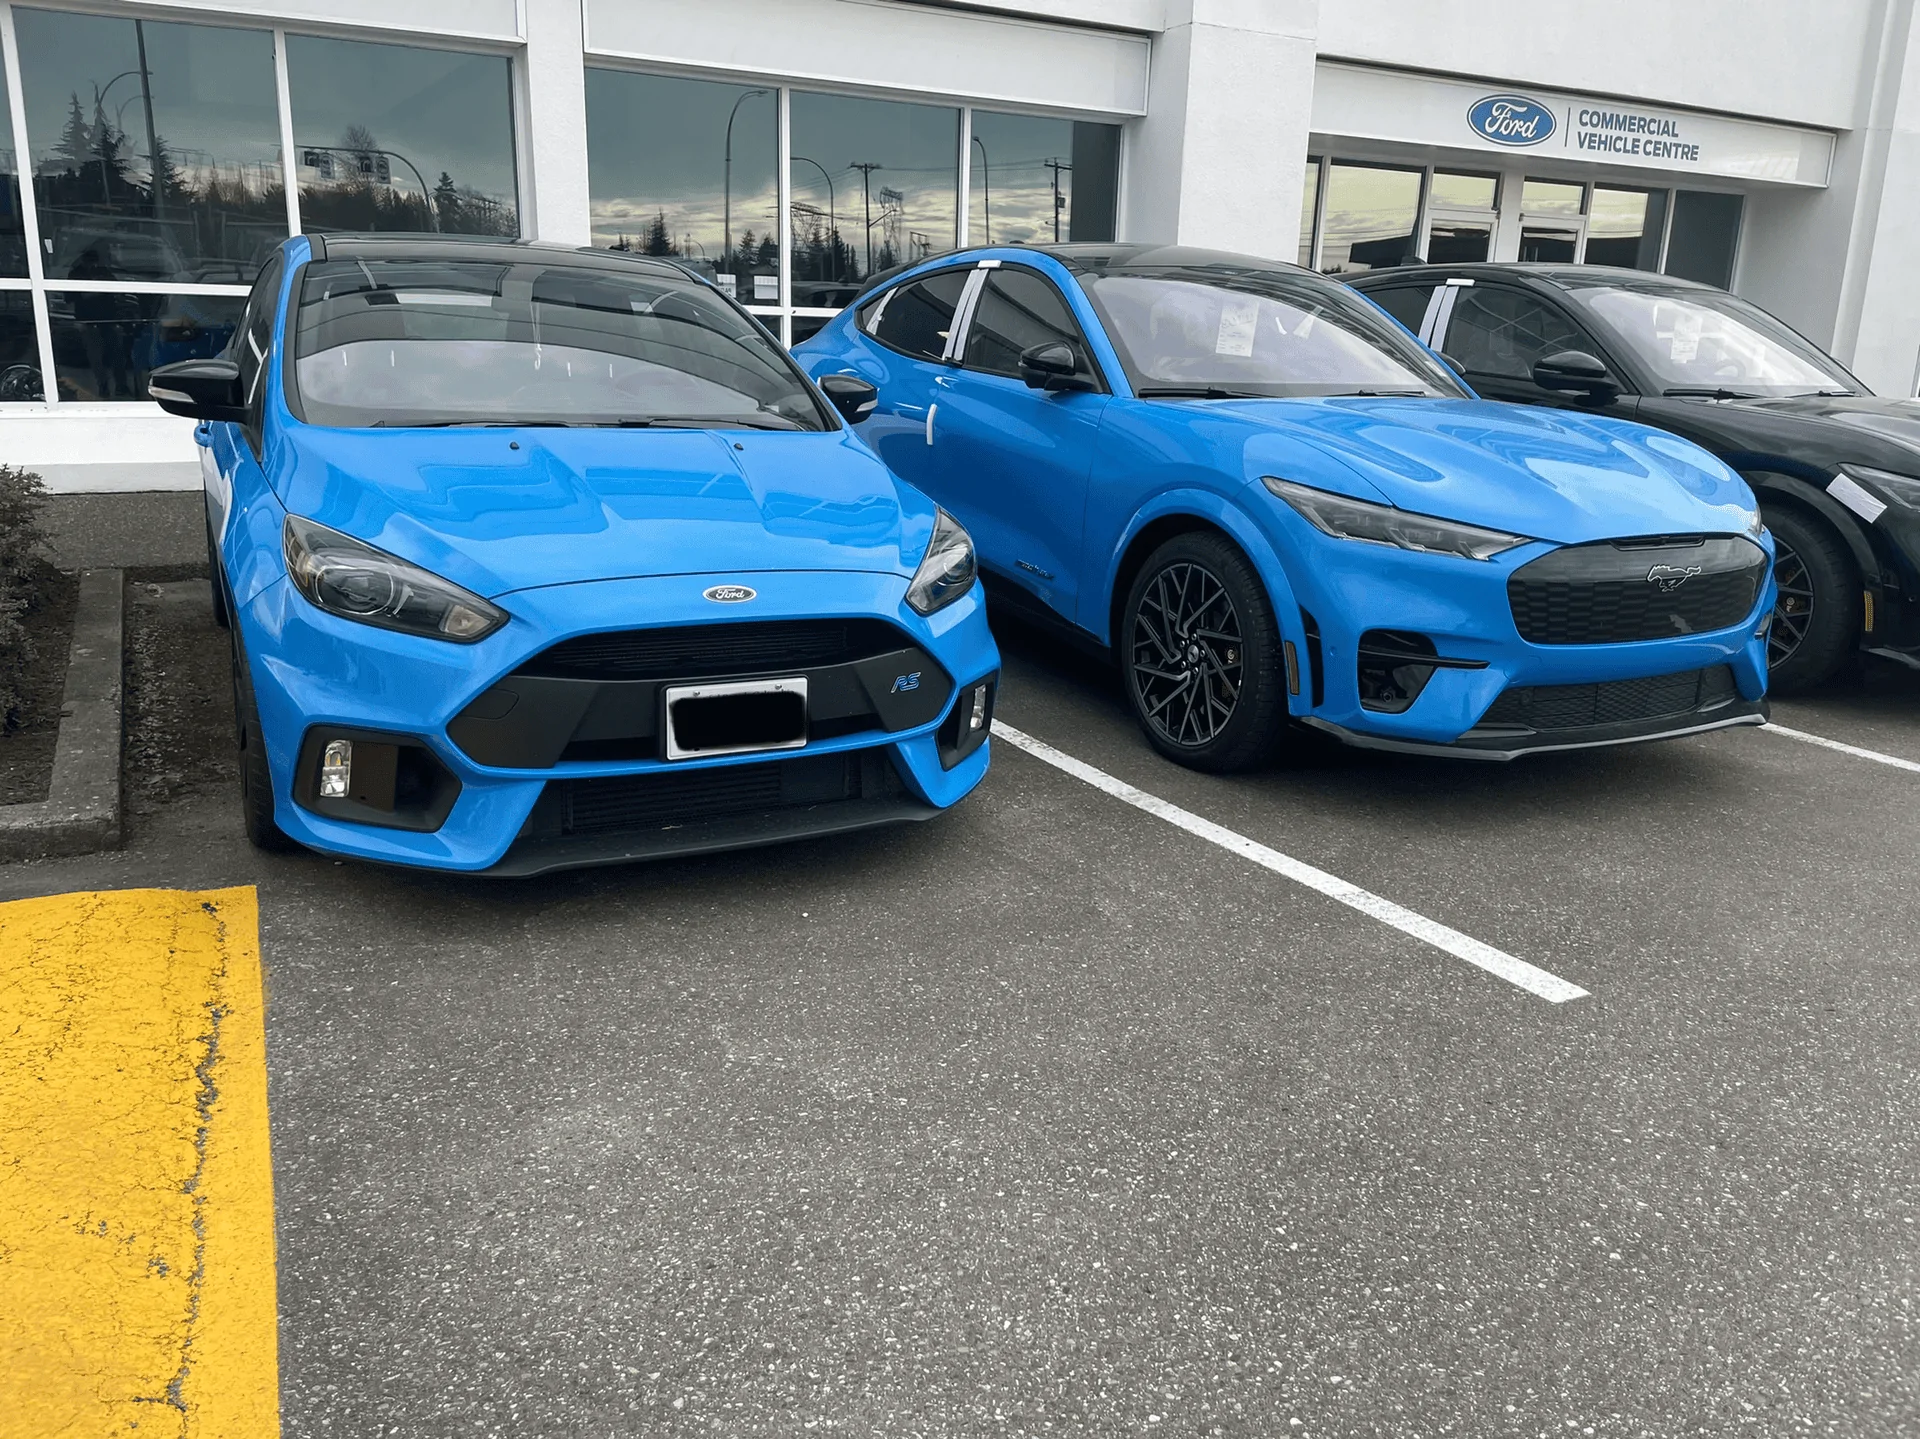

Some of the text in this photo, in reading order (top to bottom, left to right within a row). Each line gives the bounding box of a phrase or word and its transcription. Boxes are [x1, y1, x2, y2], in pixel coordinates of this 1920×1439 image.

[1485, 102, 1540, 138] Ford
[1579, 109, 1679, 138] COMMERCIAL
[1577, 131, 1700, 161] VEHICLE CENTRE
[715, 588, 745, 599] Ford
[890, 671, 921, 693] RS
